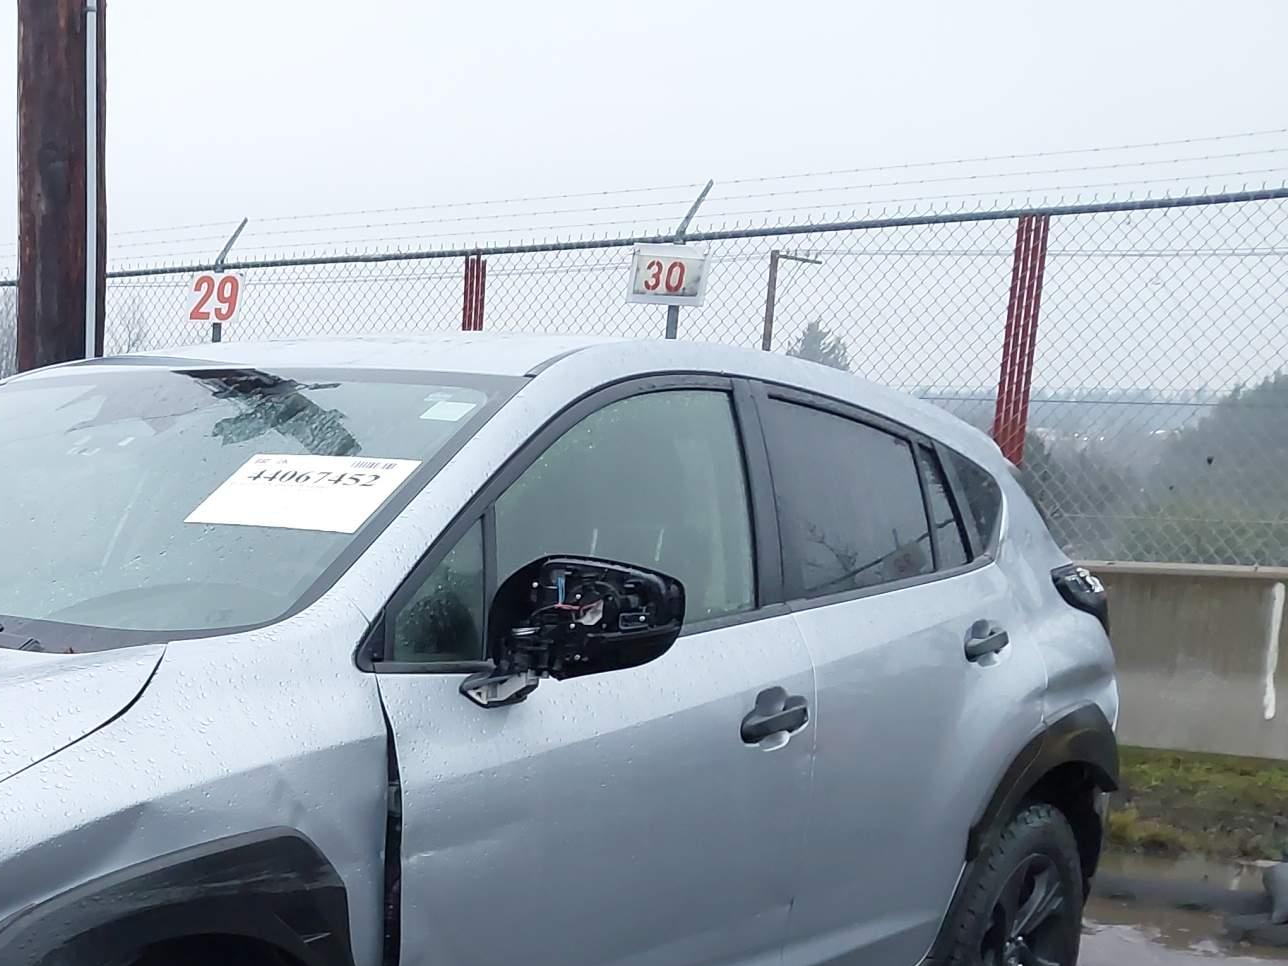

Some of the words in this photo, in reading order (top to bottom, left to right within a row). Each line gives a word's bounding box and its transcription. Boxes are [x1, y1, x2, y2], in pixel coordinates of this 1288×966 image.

[644, 260, 685, 293] 30
[189, 275, 239, 321] 29
[247, 469, 381, 487] 44067452
